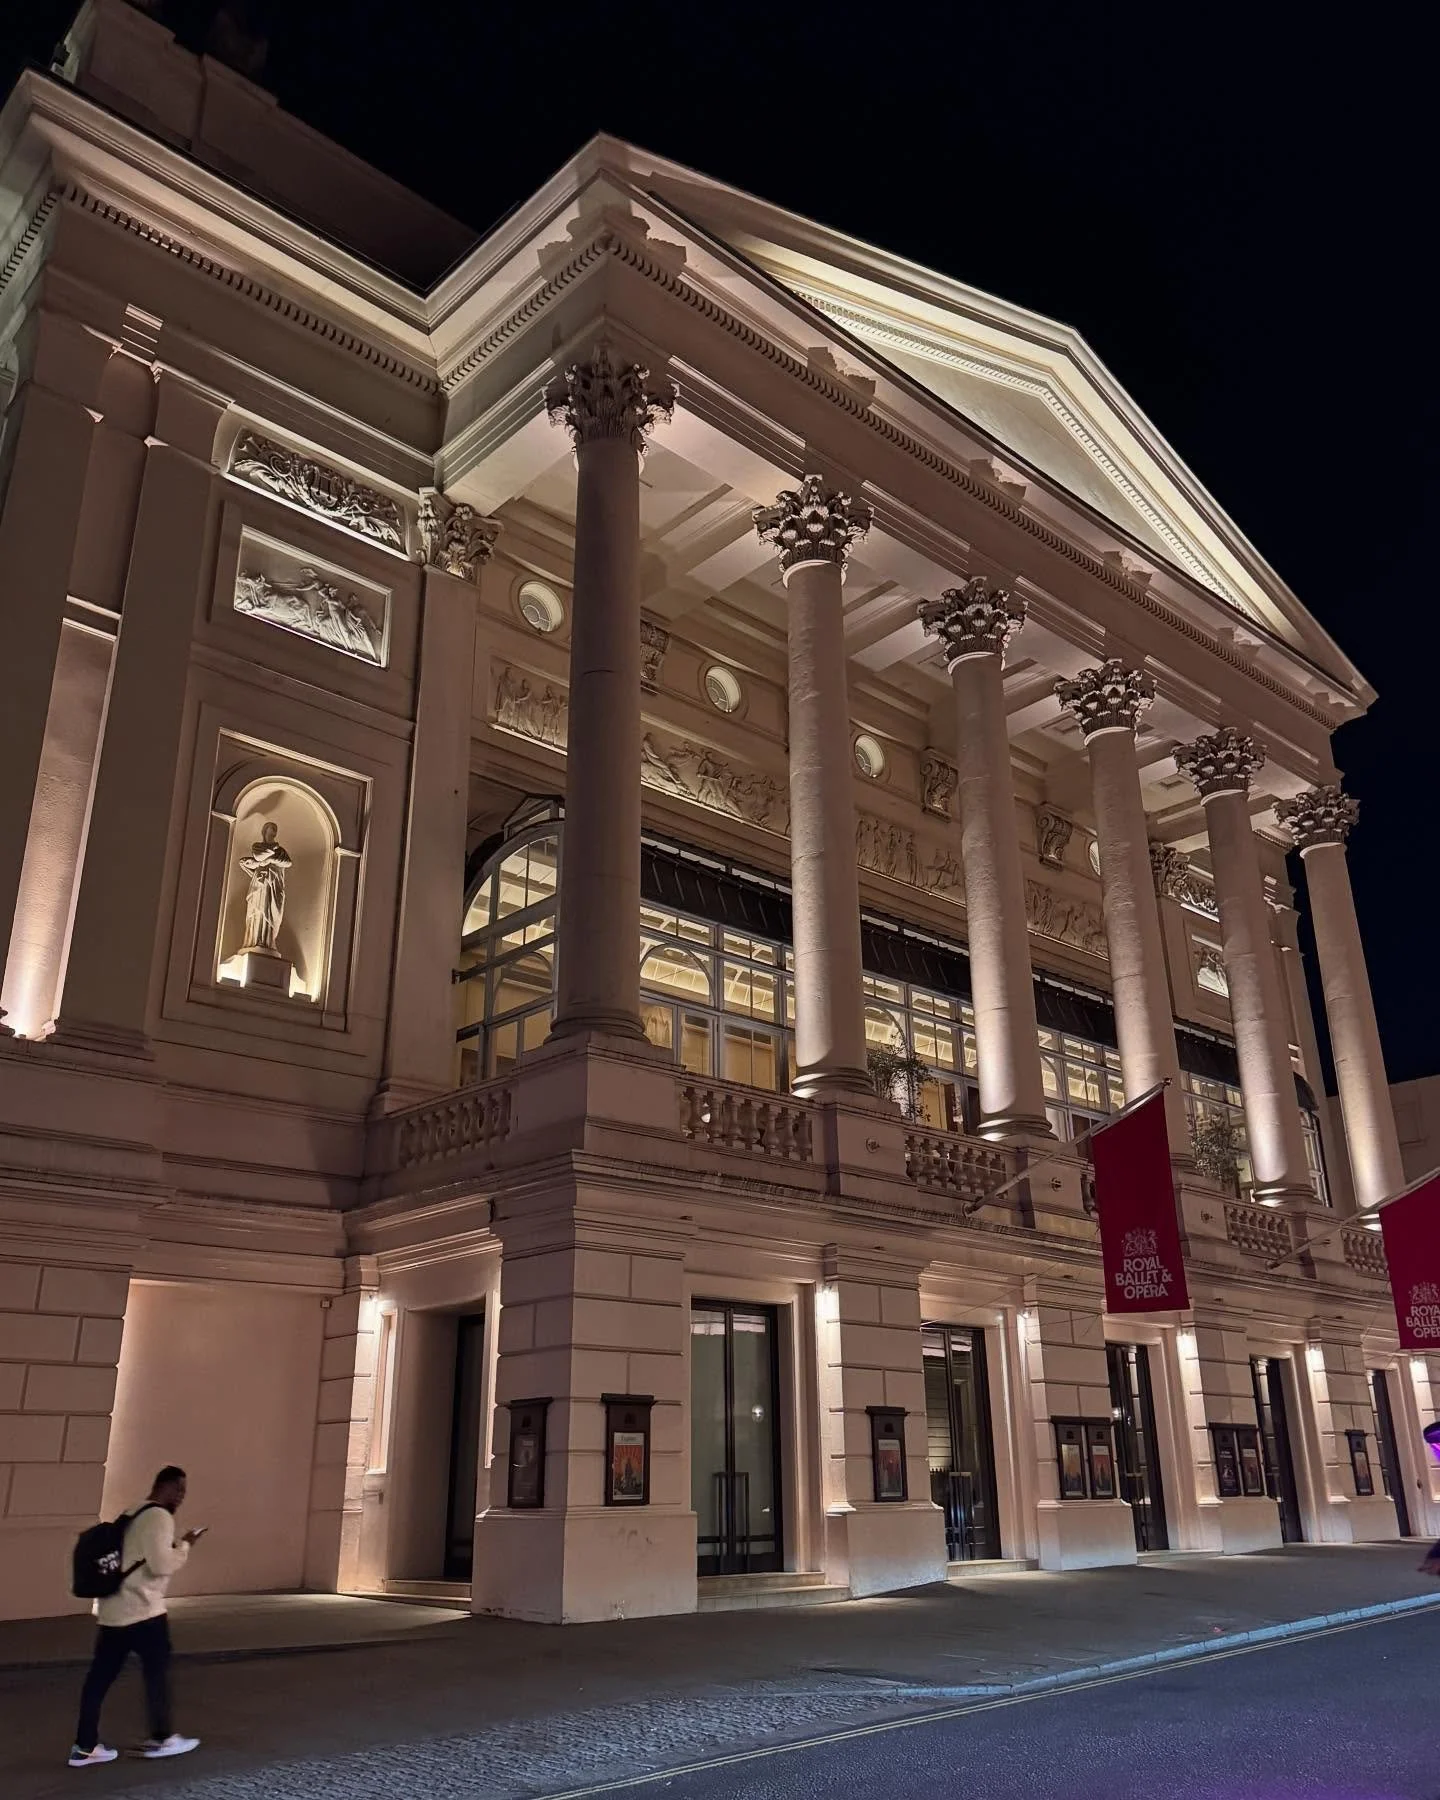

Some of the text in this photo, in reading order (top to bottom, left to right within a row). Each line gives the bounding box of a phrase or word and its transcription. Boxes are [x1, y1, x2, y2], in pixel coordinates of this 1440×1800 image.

[1123, 1256, 1164, 1273] ROYAL
[1115, 1268, 1173, 1286] BALLET &
[1124, 1283, 1168, 1299] OPERA
